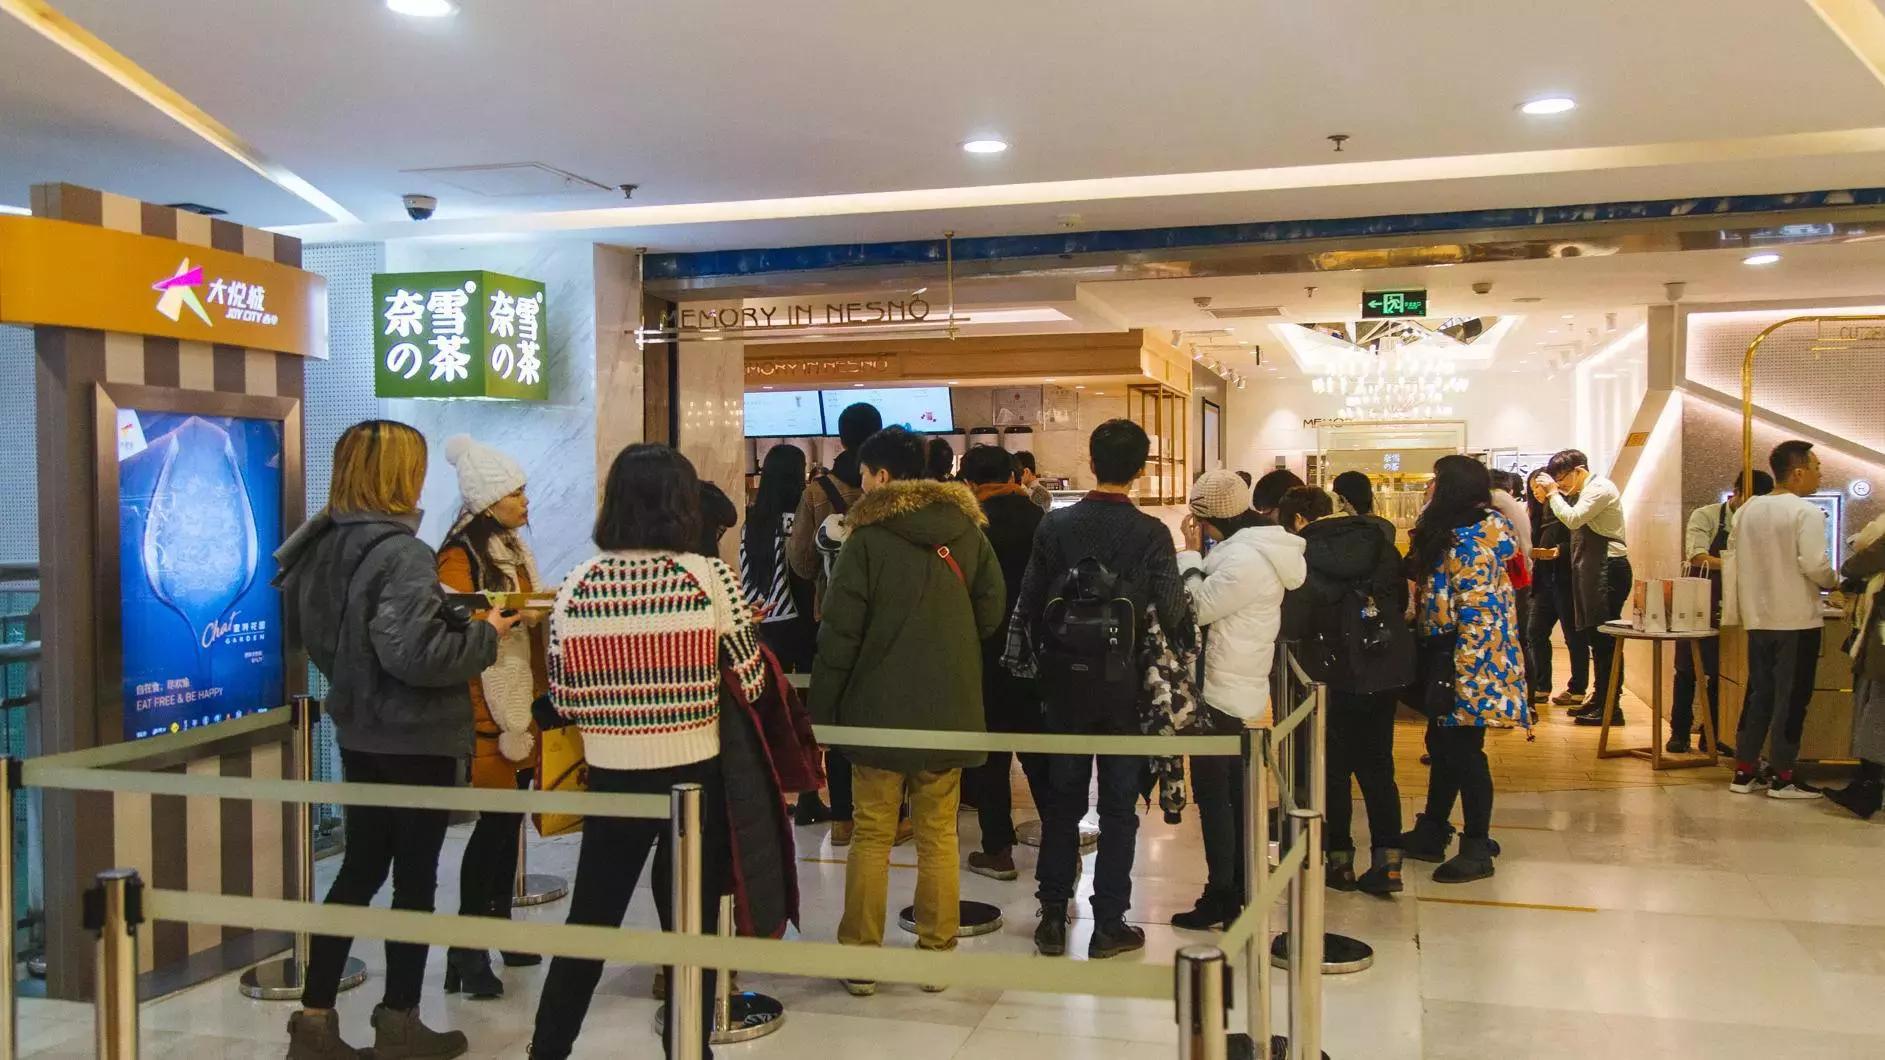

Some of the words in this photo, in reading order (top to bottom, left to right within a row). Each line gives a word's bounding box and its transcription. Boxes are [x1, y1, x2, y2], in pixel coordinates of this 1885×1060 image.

[206, 278, 266, 311] 大悦城
[225, 307, 243, 321] JOY
[243, 310, 263, 324] CITY
[384, 288, 469, 338] 奈雪
[490, 290, 540, 341] 奈雪
[788, 303, 812, 326] IN
[386, 335, 471, 382] の茶
[491, 340, 541, 385] の茶
[202, 610, 242, 648] Chat
[224, 634, 265, 645] GARDEN
[136, 698, 152, 711] EAT
[154, 694, 176, 708] FREE
[177, 693, 184, 704] &
[185, 691, 197, 703] BE
[198, 687, 224, 701] HAPPY
